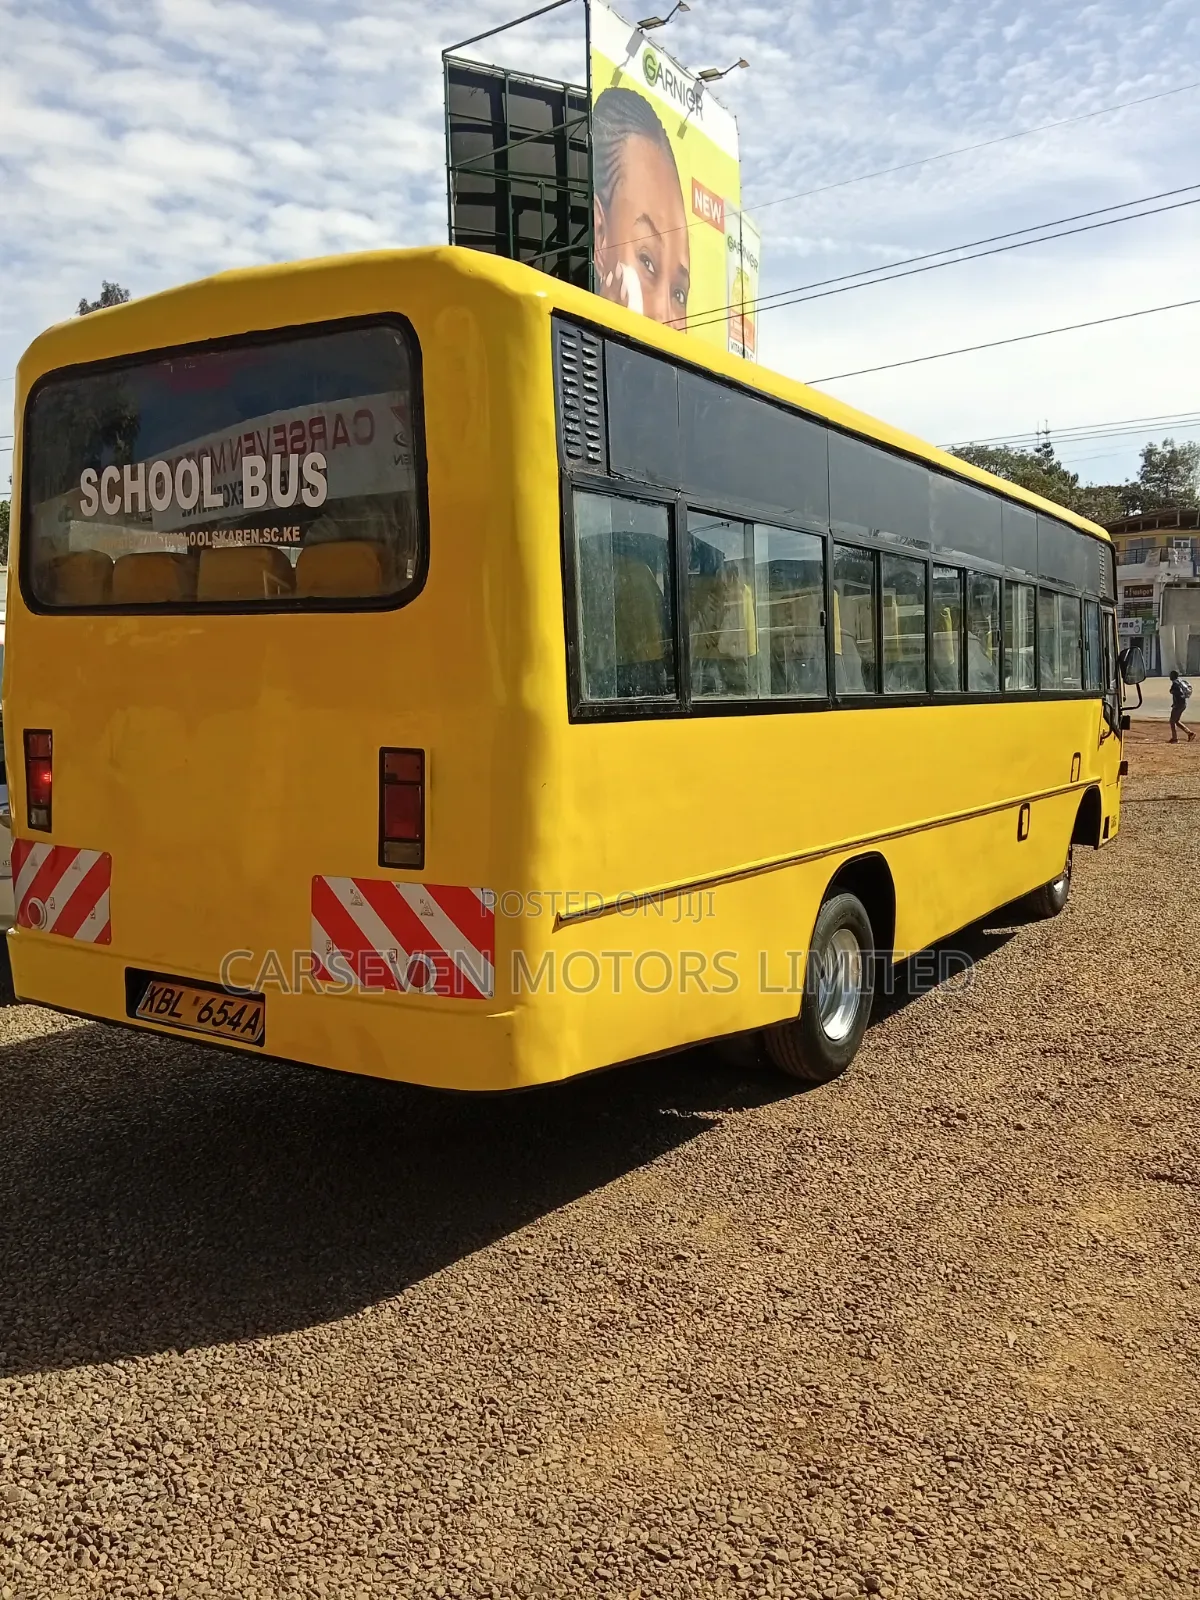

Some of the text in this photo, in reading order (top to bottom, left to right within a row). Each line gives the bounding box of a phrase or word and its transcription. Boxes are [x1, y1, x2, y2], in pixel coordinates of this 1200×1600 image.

[643, 52, 704, 121] GARNIER
[694, 187, 722, 225] NEW
[79, 456, 224, 517] SCHOOL
[242, 451, 329, 509] BUS
[141, 984, 263, 1037] KBL 654A
